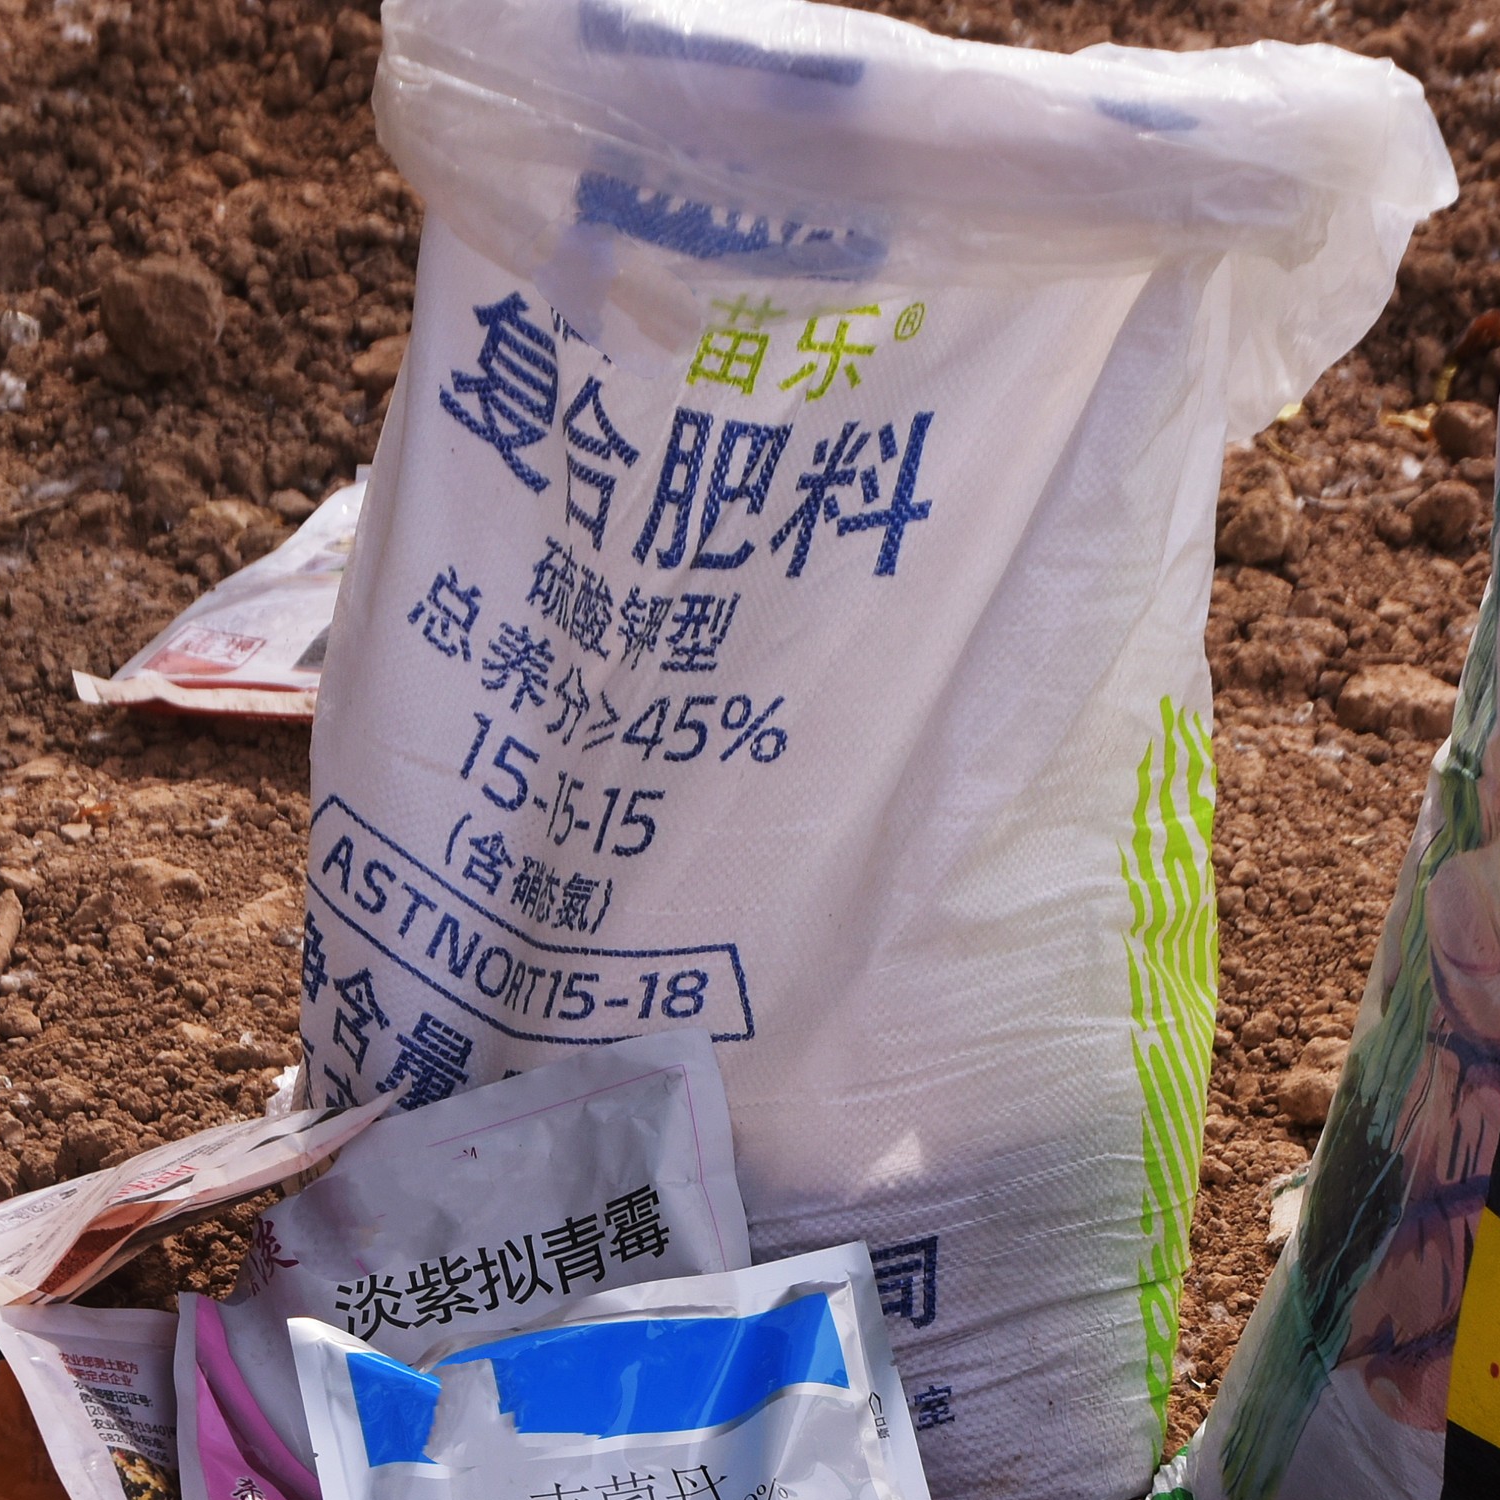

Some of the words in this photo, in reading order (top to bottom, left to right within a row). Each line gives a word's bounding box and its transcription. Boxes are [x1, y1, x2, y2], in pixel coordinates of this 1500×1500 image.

[439, 290, 933, 578] 复合肥料
[406, 564, 789, 766] 总养分≥45%
[525, 535, 742, 673] 硫酸钾型
[459, 711, 668, 858] 15-15-15
[334, 1184, 671, 1341] 淡紫拟青霉
